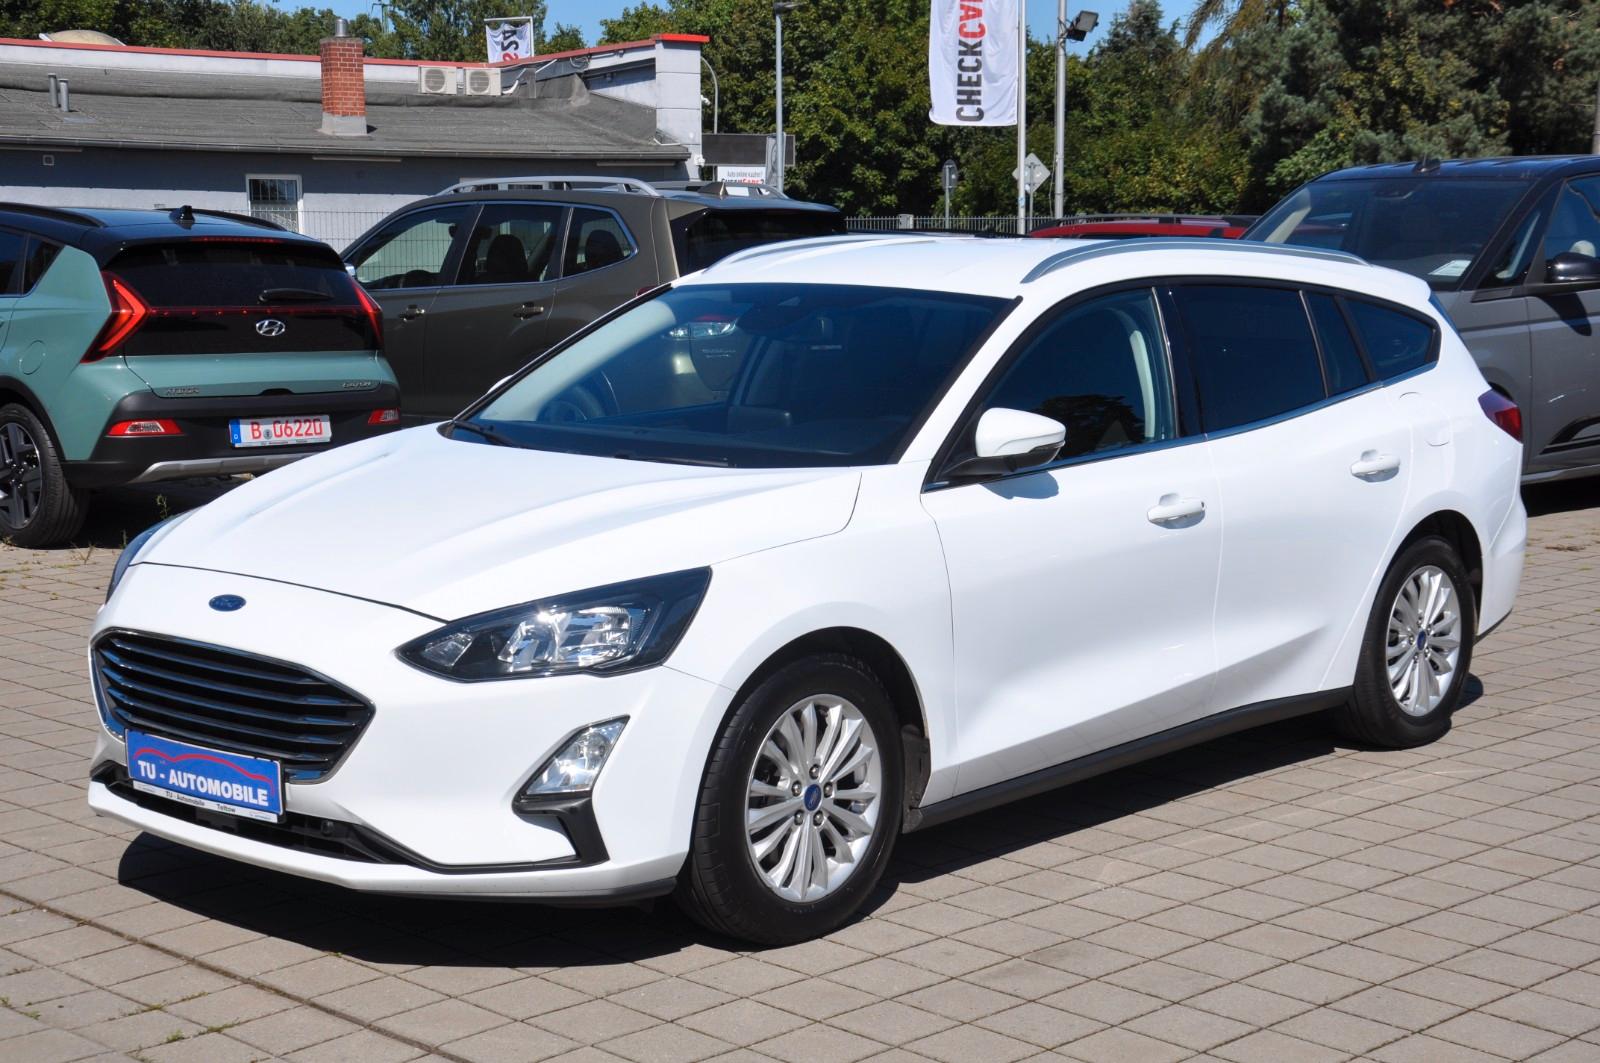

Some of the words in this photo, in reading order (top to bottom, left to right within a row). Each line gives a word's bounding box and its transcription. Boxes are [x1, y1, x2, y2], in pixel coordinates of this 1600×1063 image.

[251, 421, 262, 439] B
[138, 760, 156, 779] TU
[169, 769, 268, 806] AUTOMOBILE
